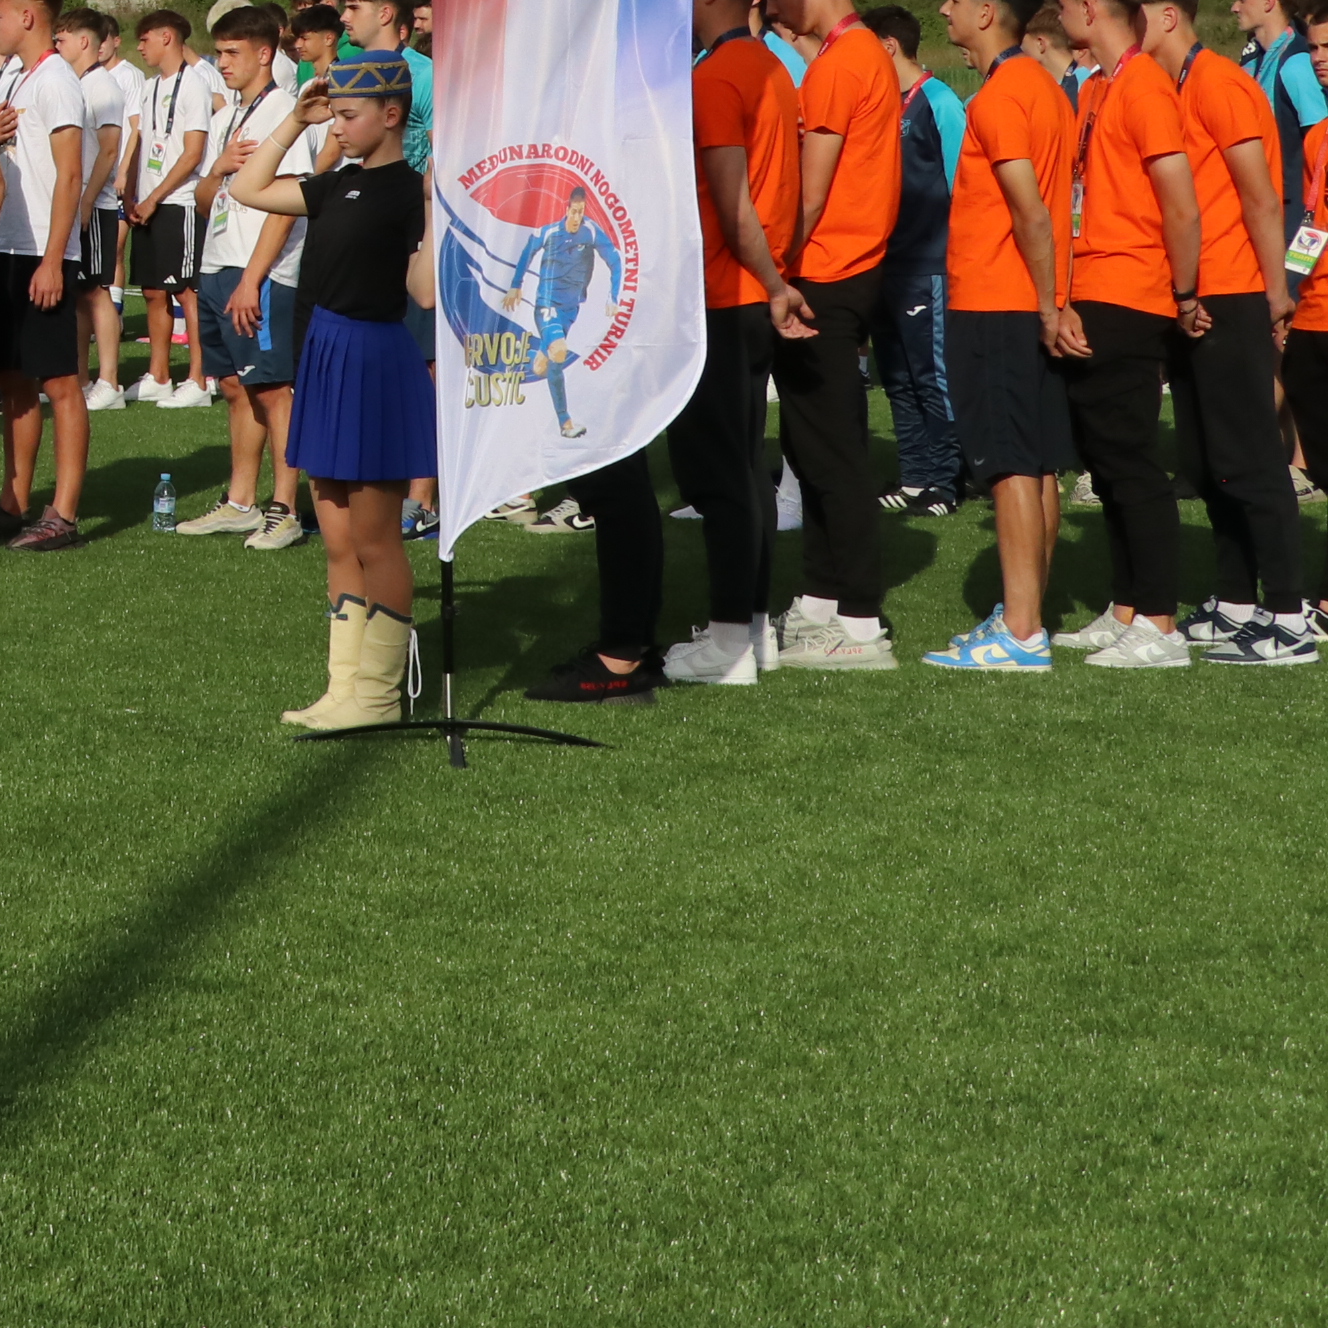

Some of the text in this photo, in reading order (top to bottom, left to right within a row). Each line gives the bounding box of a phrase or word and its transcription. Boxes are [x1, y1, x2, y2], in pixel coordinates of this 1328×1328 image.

[457, 142, 639, 372] MEĐUNARODNI NOGOMETNI TURNIR
